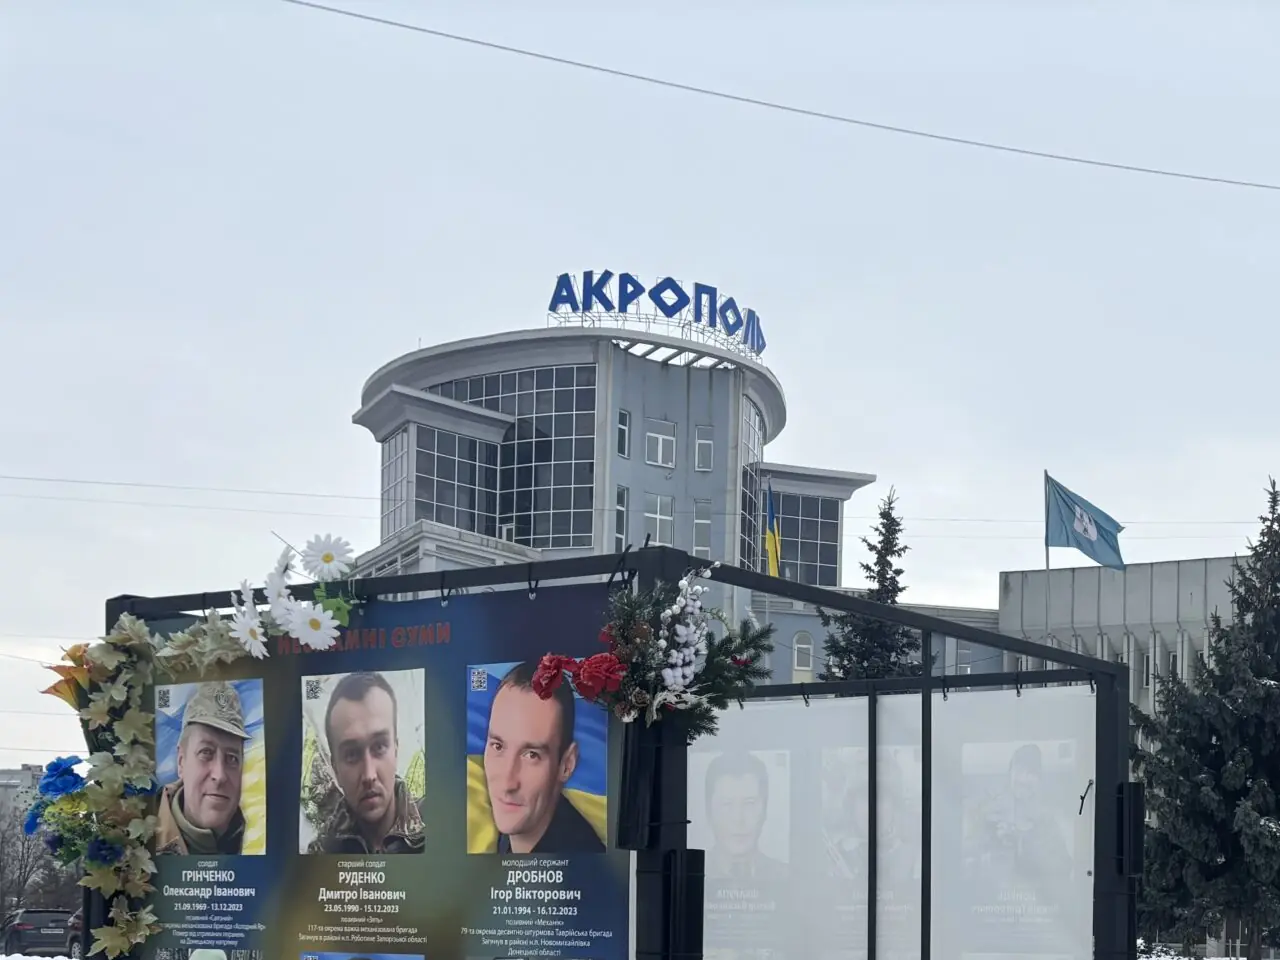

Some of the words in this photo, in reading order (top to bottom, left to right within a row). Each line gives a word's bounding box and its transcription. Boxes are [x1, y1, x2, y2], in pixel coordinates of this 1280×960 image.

[548, 269, 766, 355] АКРОПОЛЬ
[391, 622, 450, 648] СУМИ
[501, 858, 538, 868] молодший
[539, 859, 569, 868] сержант
[182, 870, 235, 882] ГРІНЧЕНКО
[338, 871, 386, 886] РУДЕНКО
[507, 870, 564, 885] ДРОБНОВ
[163, 885, 212, 899] Олександр
[214, 885, 256, 897] Іванович
[318, 887, 358, 902] Дмитро
[359, 887, 406, 900] Іванович
[490, 887, 513, 902] Ігор
[515, 887, 581, 903] Вікторович
[174, 903, 207, 911] 21.09.1969
[211, 903, 243, 911] 13.12.2023
[324, 904, 359, 912] 23.05.1990
[364, 904, 399, 913] 15.12.2023
[492, 906, 532, 915] 21.01.1994
[537, 906, 578, 916] 16.12.2023
[589, 928, 613, 940] бригада
